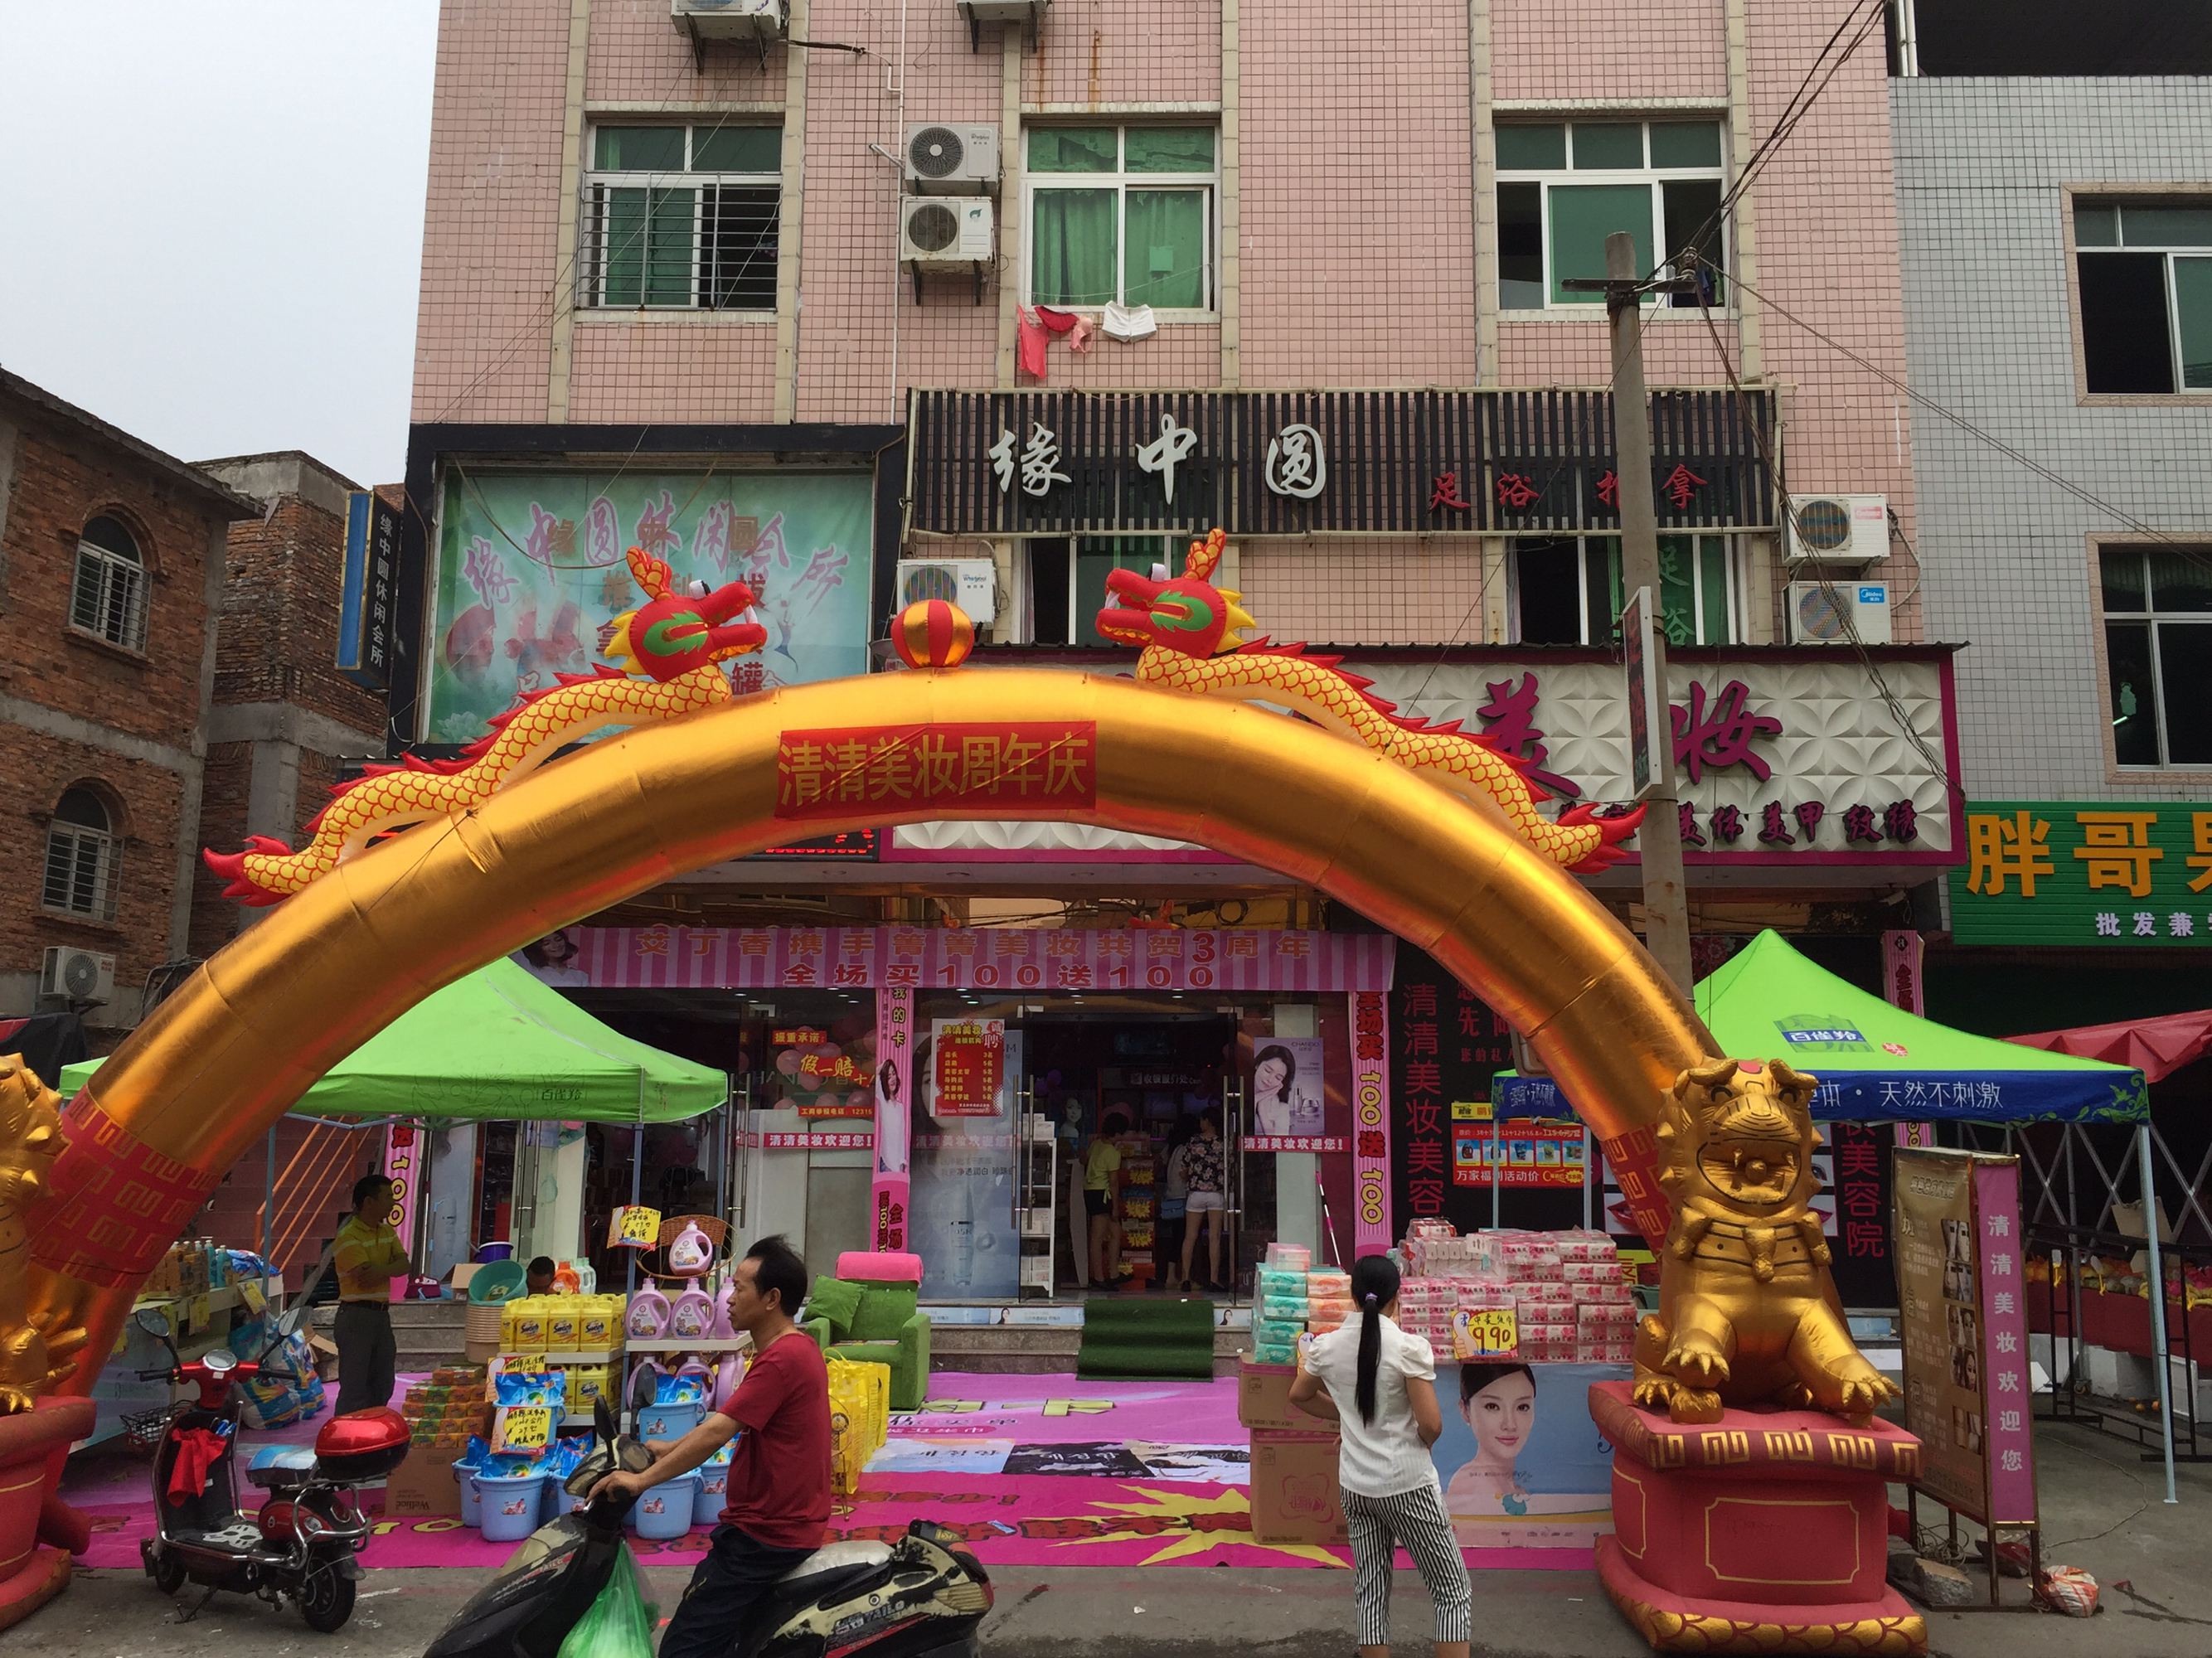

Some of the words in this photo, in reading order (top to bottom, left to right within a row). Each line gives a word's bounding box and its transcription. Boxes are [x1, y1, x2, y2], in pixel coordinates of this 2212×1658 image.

[989, 414, 1327, 505] 缘中圆
[1429, 472, 1540, 511] 足浴
[371, 513, 393, 668] 缘中圆休闲会所
[778, 731, 1089, 807] 清清美妆周年庆
[1758, 799, 1825, 846] 美甲
[1843, 799, 1918, 844] 纹绣
[2096, 912, 2212, 937] 批发兼
[783, 963, 1214, 988] 全场买100送100
[890, 988, 906, 1049] 我的卡
[942, 1024, 982, 1035] 清清美妆
[1789, 1030, 1859, 1042] 百雀羚
[800, 1054, 876, 1088] 假一赔十!
[541, 1088, 581, 1101] 百雀羚
[1403, 983, 1446, 1215] 清清美妆美容
[851, 1108, 873, 1116] 12315
[769, 1134, 872, 1147] 清清美妆欢迎您!
[1244, 1137, 1344, 1151] 清清美妆欢迎您!
[1987, 1214, 2024, 1473] 清清美妆欢迎您
